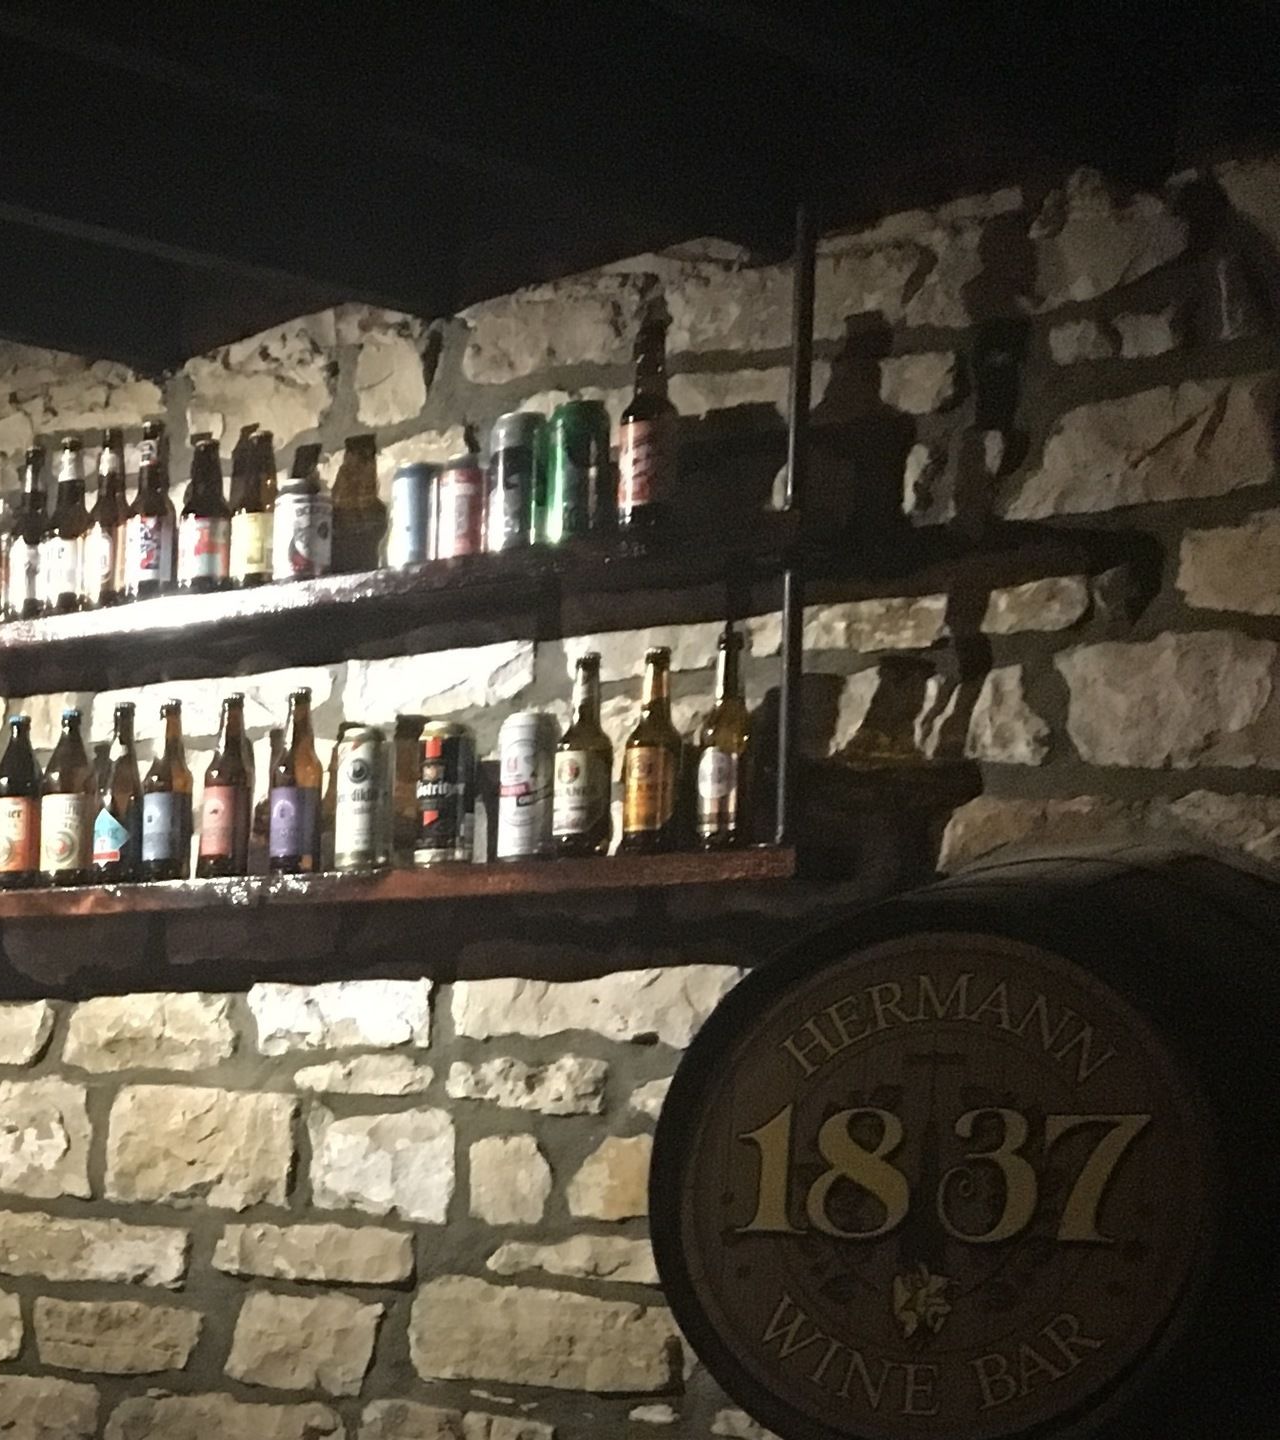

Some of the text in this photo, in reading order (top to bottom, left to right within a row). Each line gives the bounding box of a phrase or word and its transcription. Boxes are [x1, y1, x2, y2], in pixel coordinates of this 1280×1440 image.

[780, 973, 1117, 1084] HERMANN
[735, 1103, 1152, 1243] 1837
[761, 1293, 1107, 1417] WINE BAR
